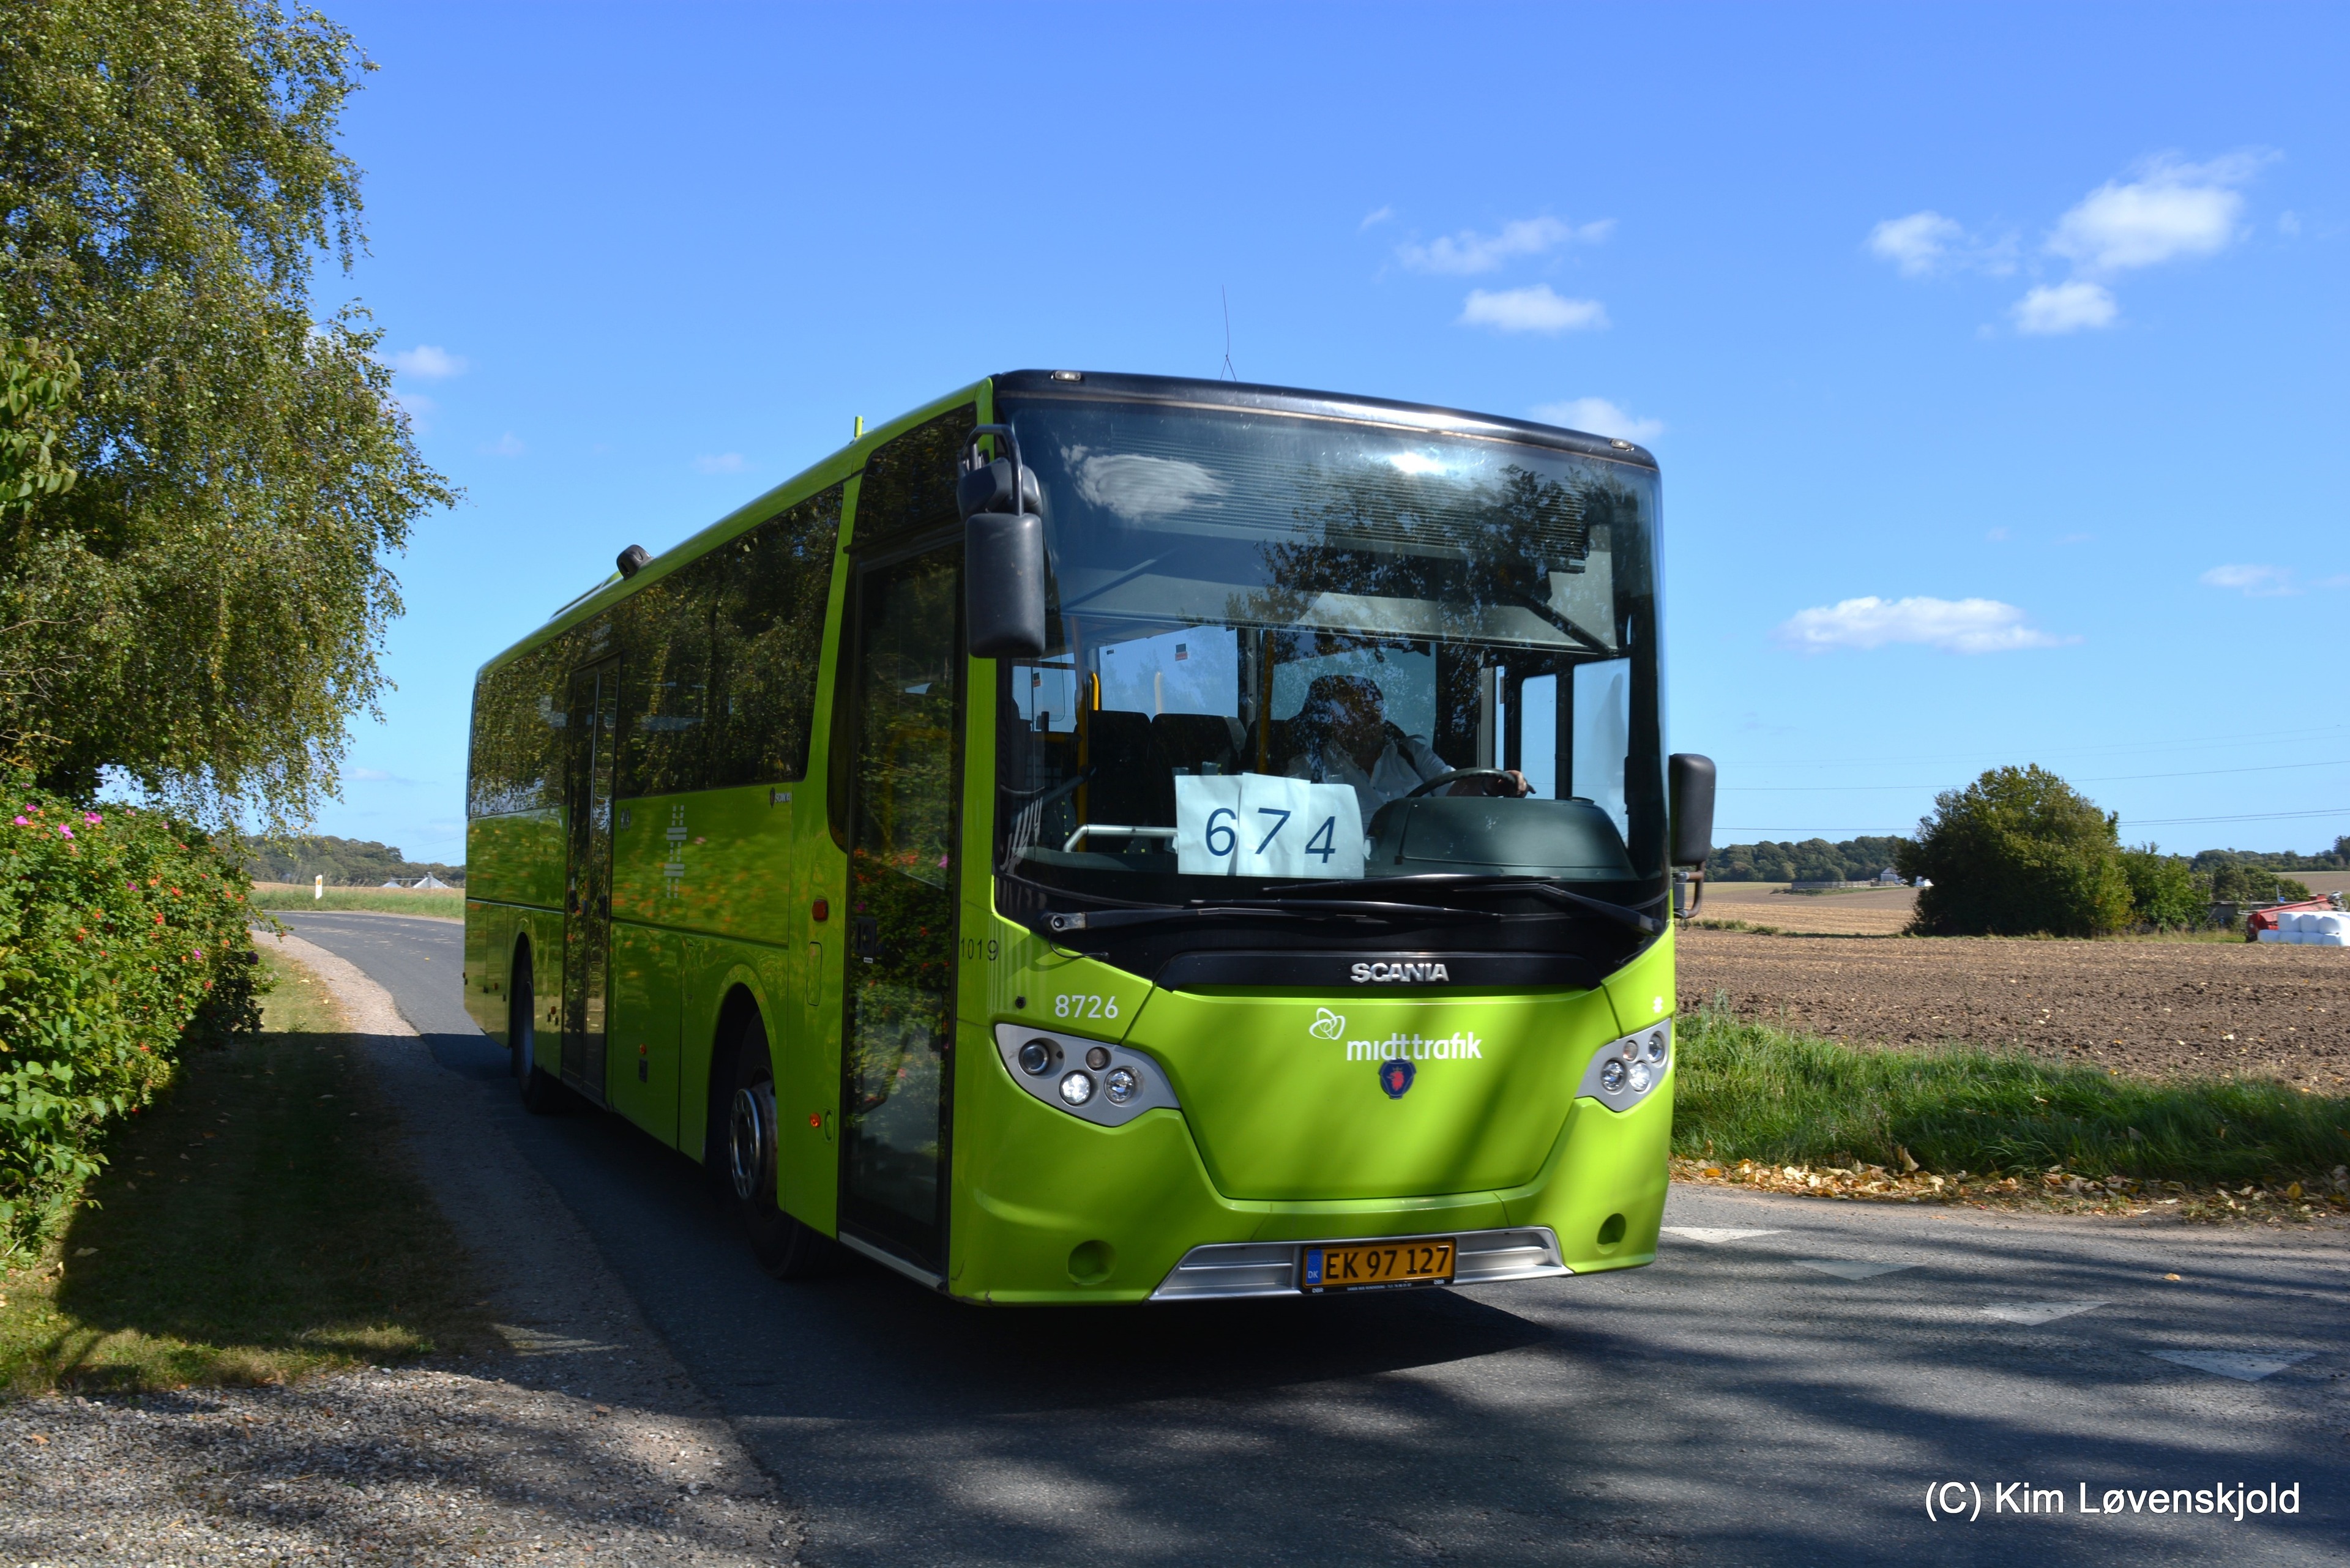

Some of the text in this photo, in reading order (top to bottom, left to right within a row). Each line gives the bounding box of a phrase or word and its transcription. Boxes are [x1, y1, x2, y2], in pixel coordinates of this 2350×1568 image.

[1206, 807, 1336, 864] 674
[960, 937, 999, 961] 1019
[1350, 963, 1449, 983] SCANIA
[1054, 995, 1119, 1019] 8726
[1346, 1031, 1483, 1061] midttrafik
[1326, 1245, 1449, 1279] EK 97 127
[1307, 1271, 1318, 1279] DK
